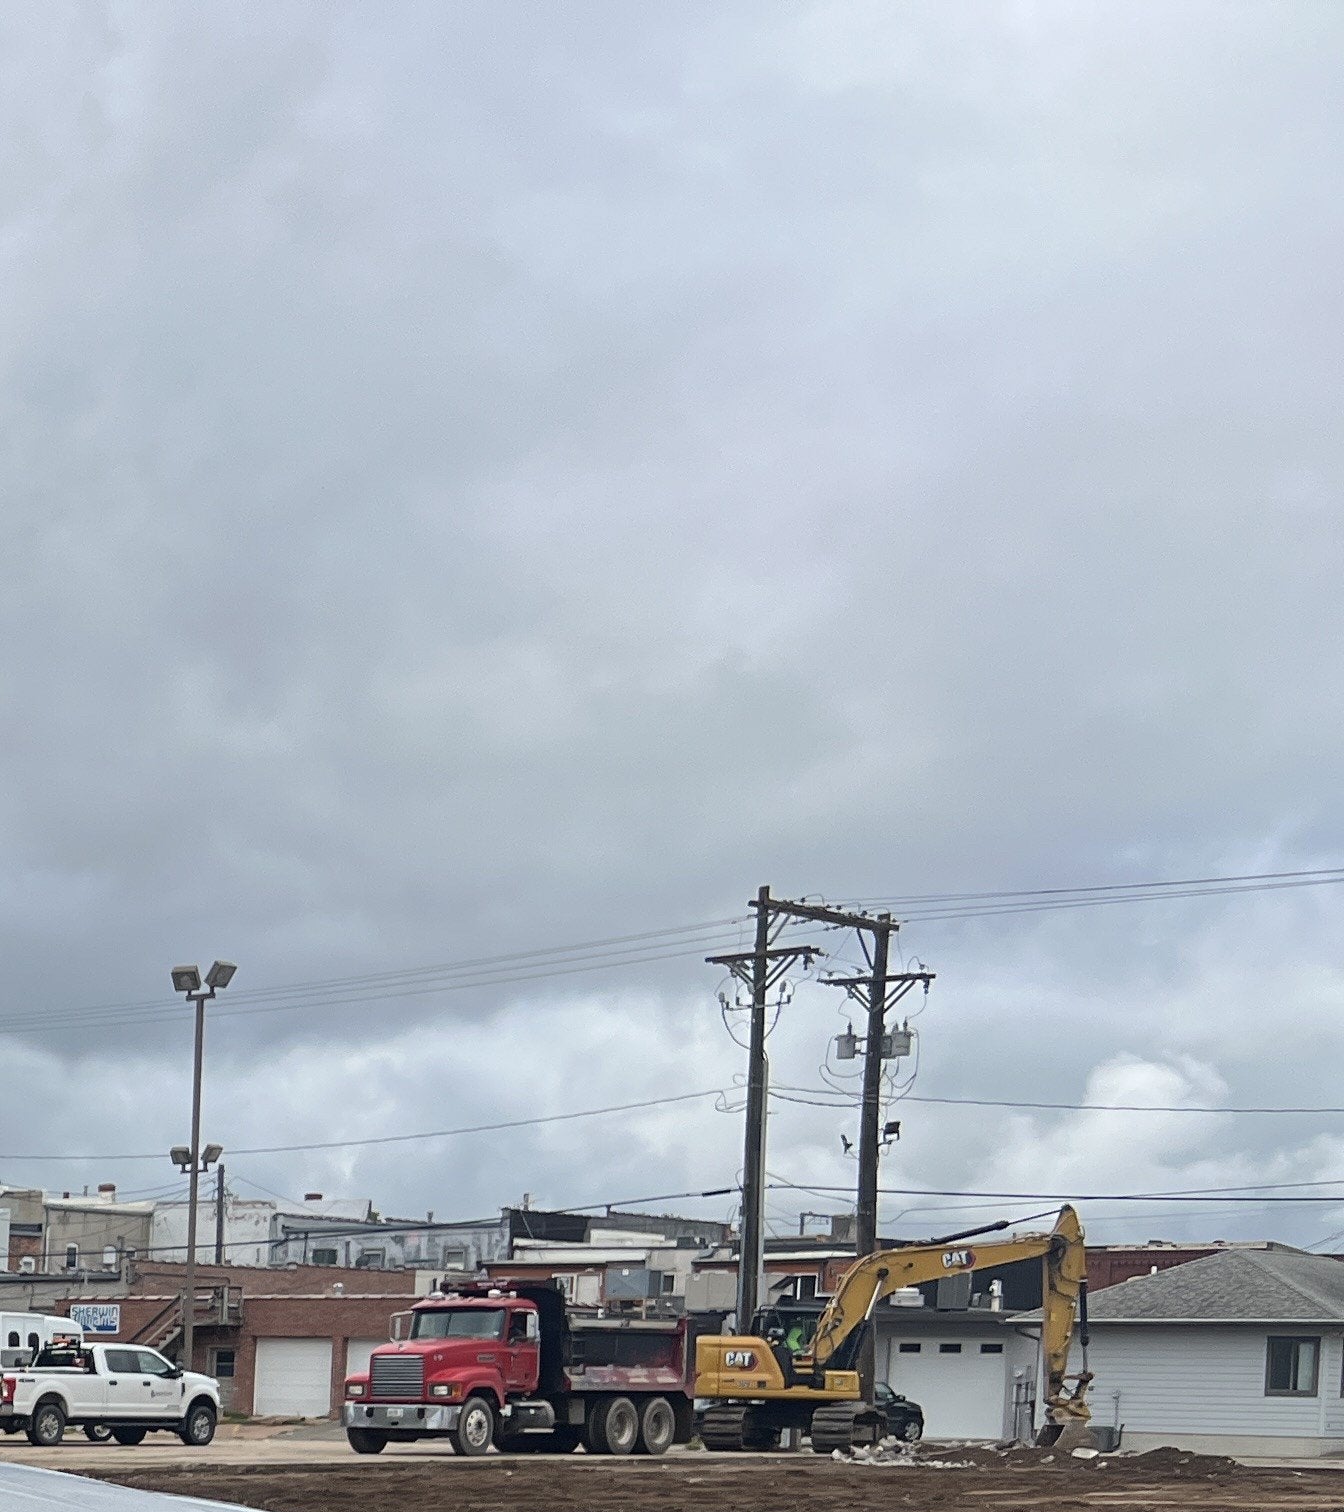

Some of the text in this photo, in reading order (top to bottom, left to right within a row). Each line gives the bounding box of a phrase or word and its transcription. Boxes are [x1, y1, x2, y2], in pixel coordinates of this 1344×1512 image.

[942, 1250, 968, 1268] CAT
[72, 1307, 118, 1318] SHERWIN
[725, 1351, 752, 1368] CAT
